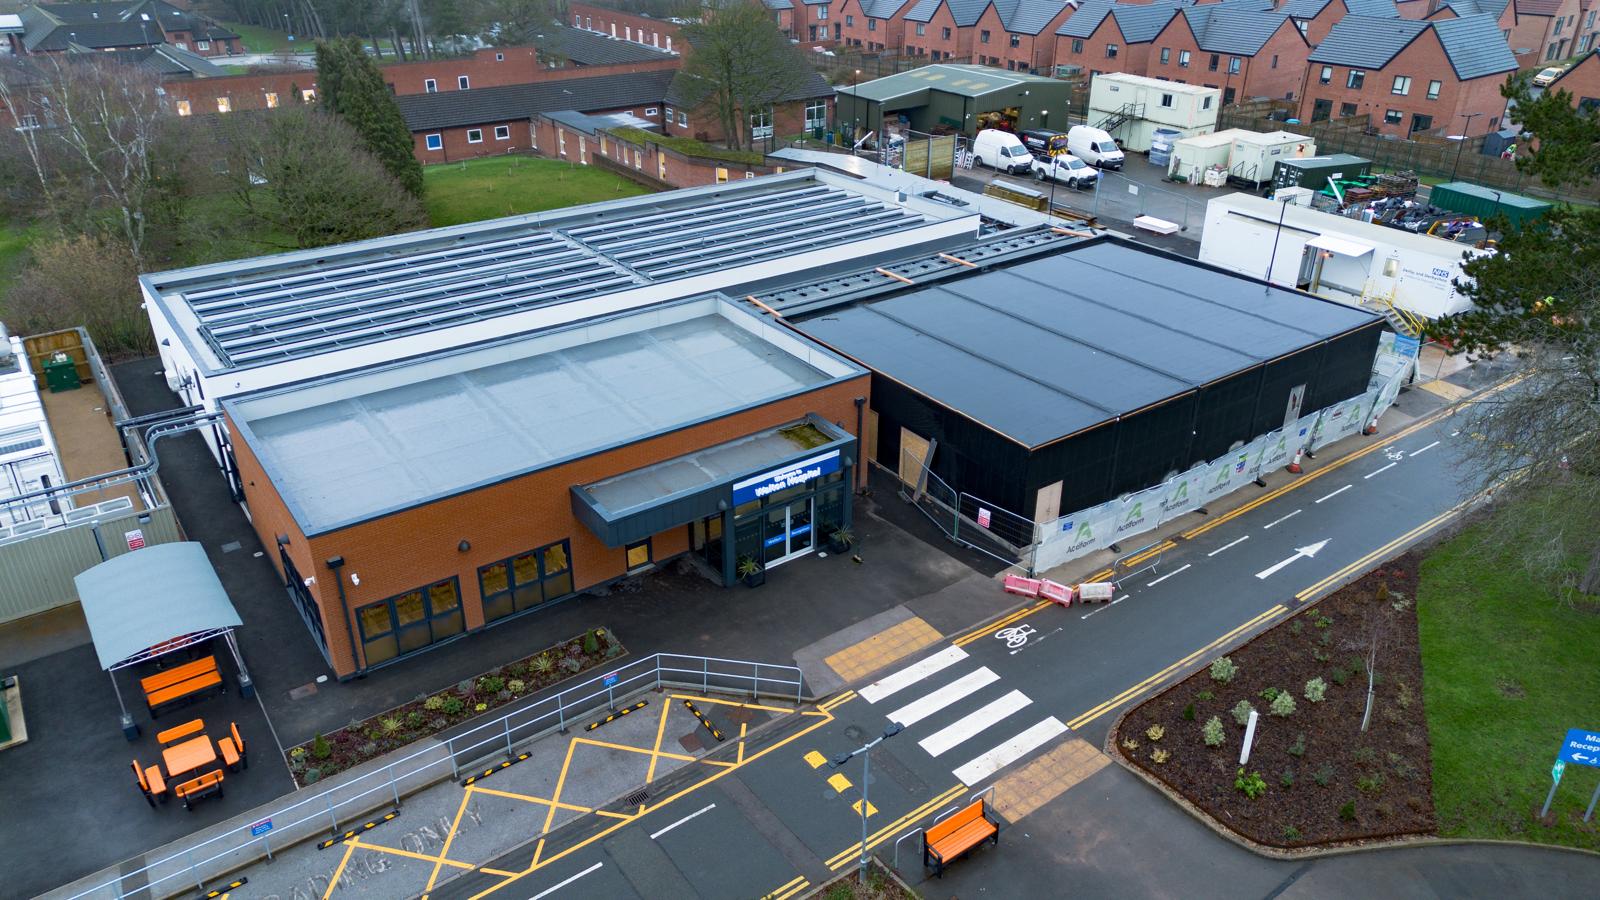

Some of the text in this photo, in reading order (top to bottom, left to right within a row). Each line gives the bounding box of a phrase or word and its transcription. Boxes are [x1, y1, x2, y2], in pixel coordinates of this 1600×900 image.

[1432, 268, 1449, 278] NHS
[755, 467, 821, 497] Walton Hospital
